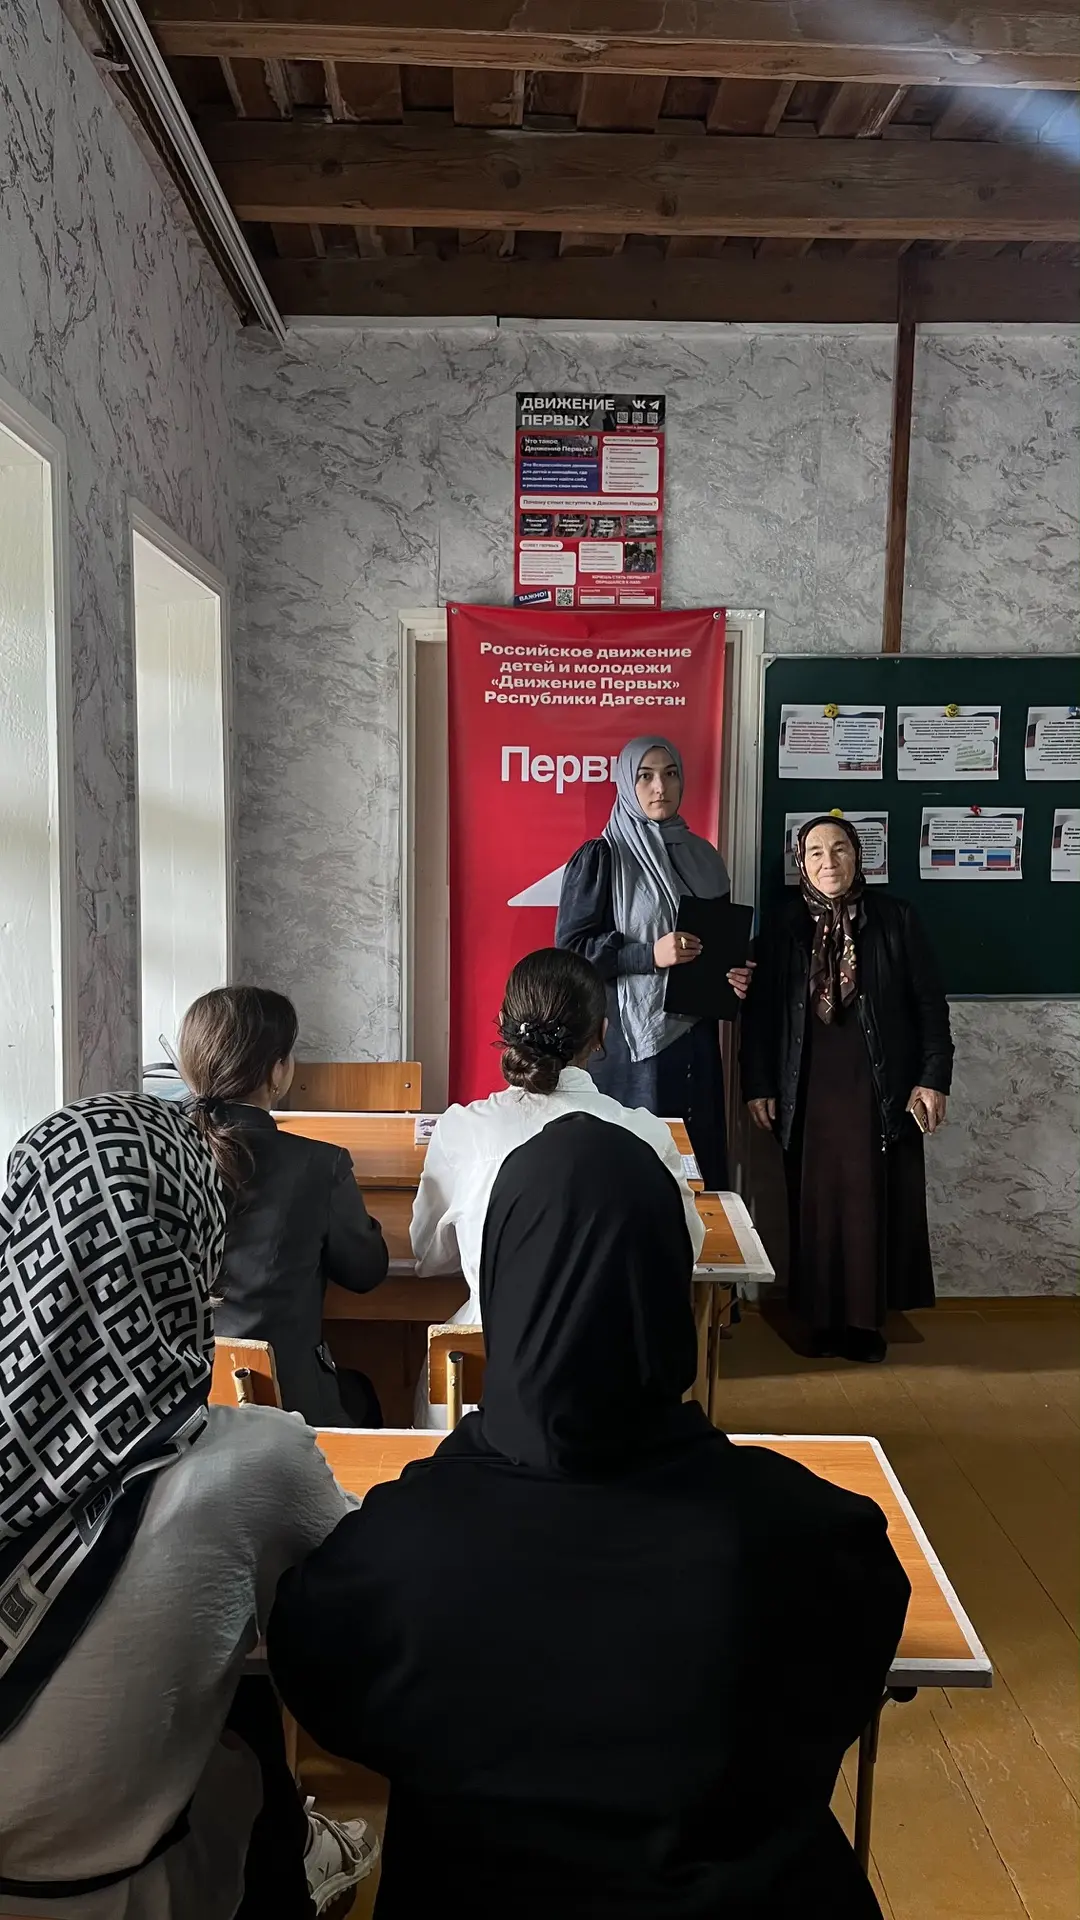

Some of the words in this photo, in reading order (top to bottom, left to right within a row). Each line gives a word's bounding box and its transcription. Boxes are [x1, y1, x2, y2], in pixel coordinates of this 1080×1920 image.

[521, 397, 615, 411] ДВИЖЕНИЕ
[521, 414, 589, 427] ПЕРВЫХ
[480, 642, 593, 658] Российское
[596, 648, 692, 659] движение
[500, 661, 555, 673] детей
[559, 665, 570, 673] и
[574, 665, 672, 674] молодежи
[491, 675, 597, 690] «Движение
[600, 678, 680, 692] Первых»
[484, 691, 597, 706] Республики
[600, 694, 686, 706] Дагестан
